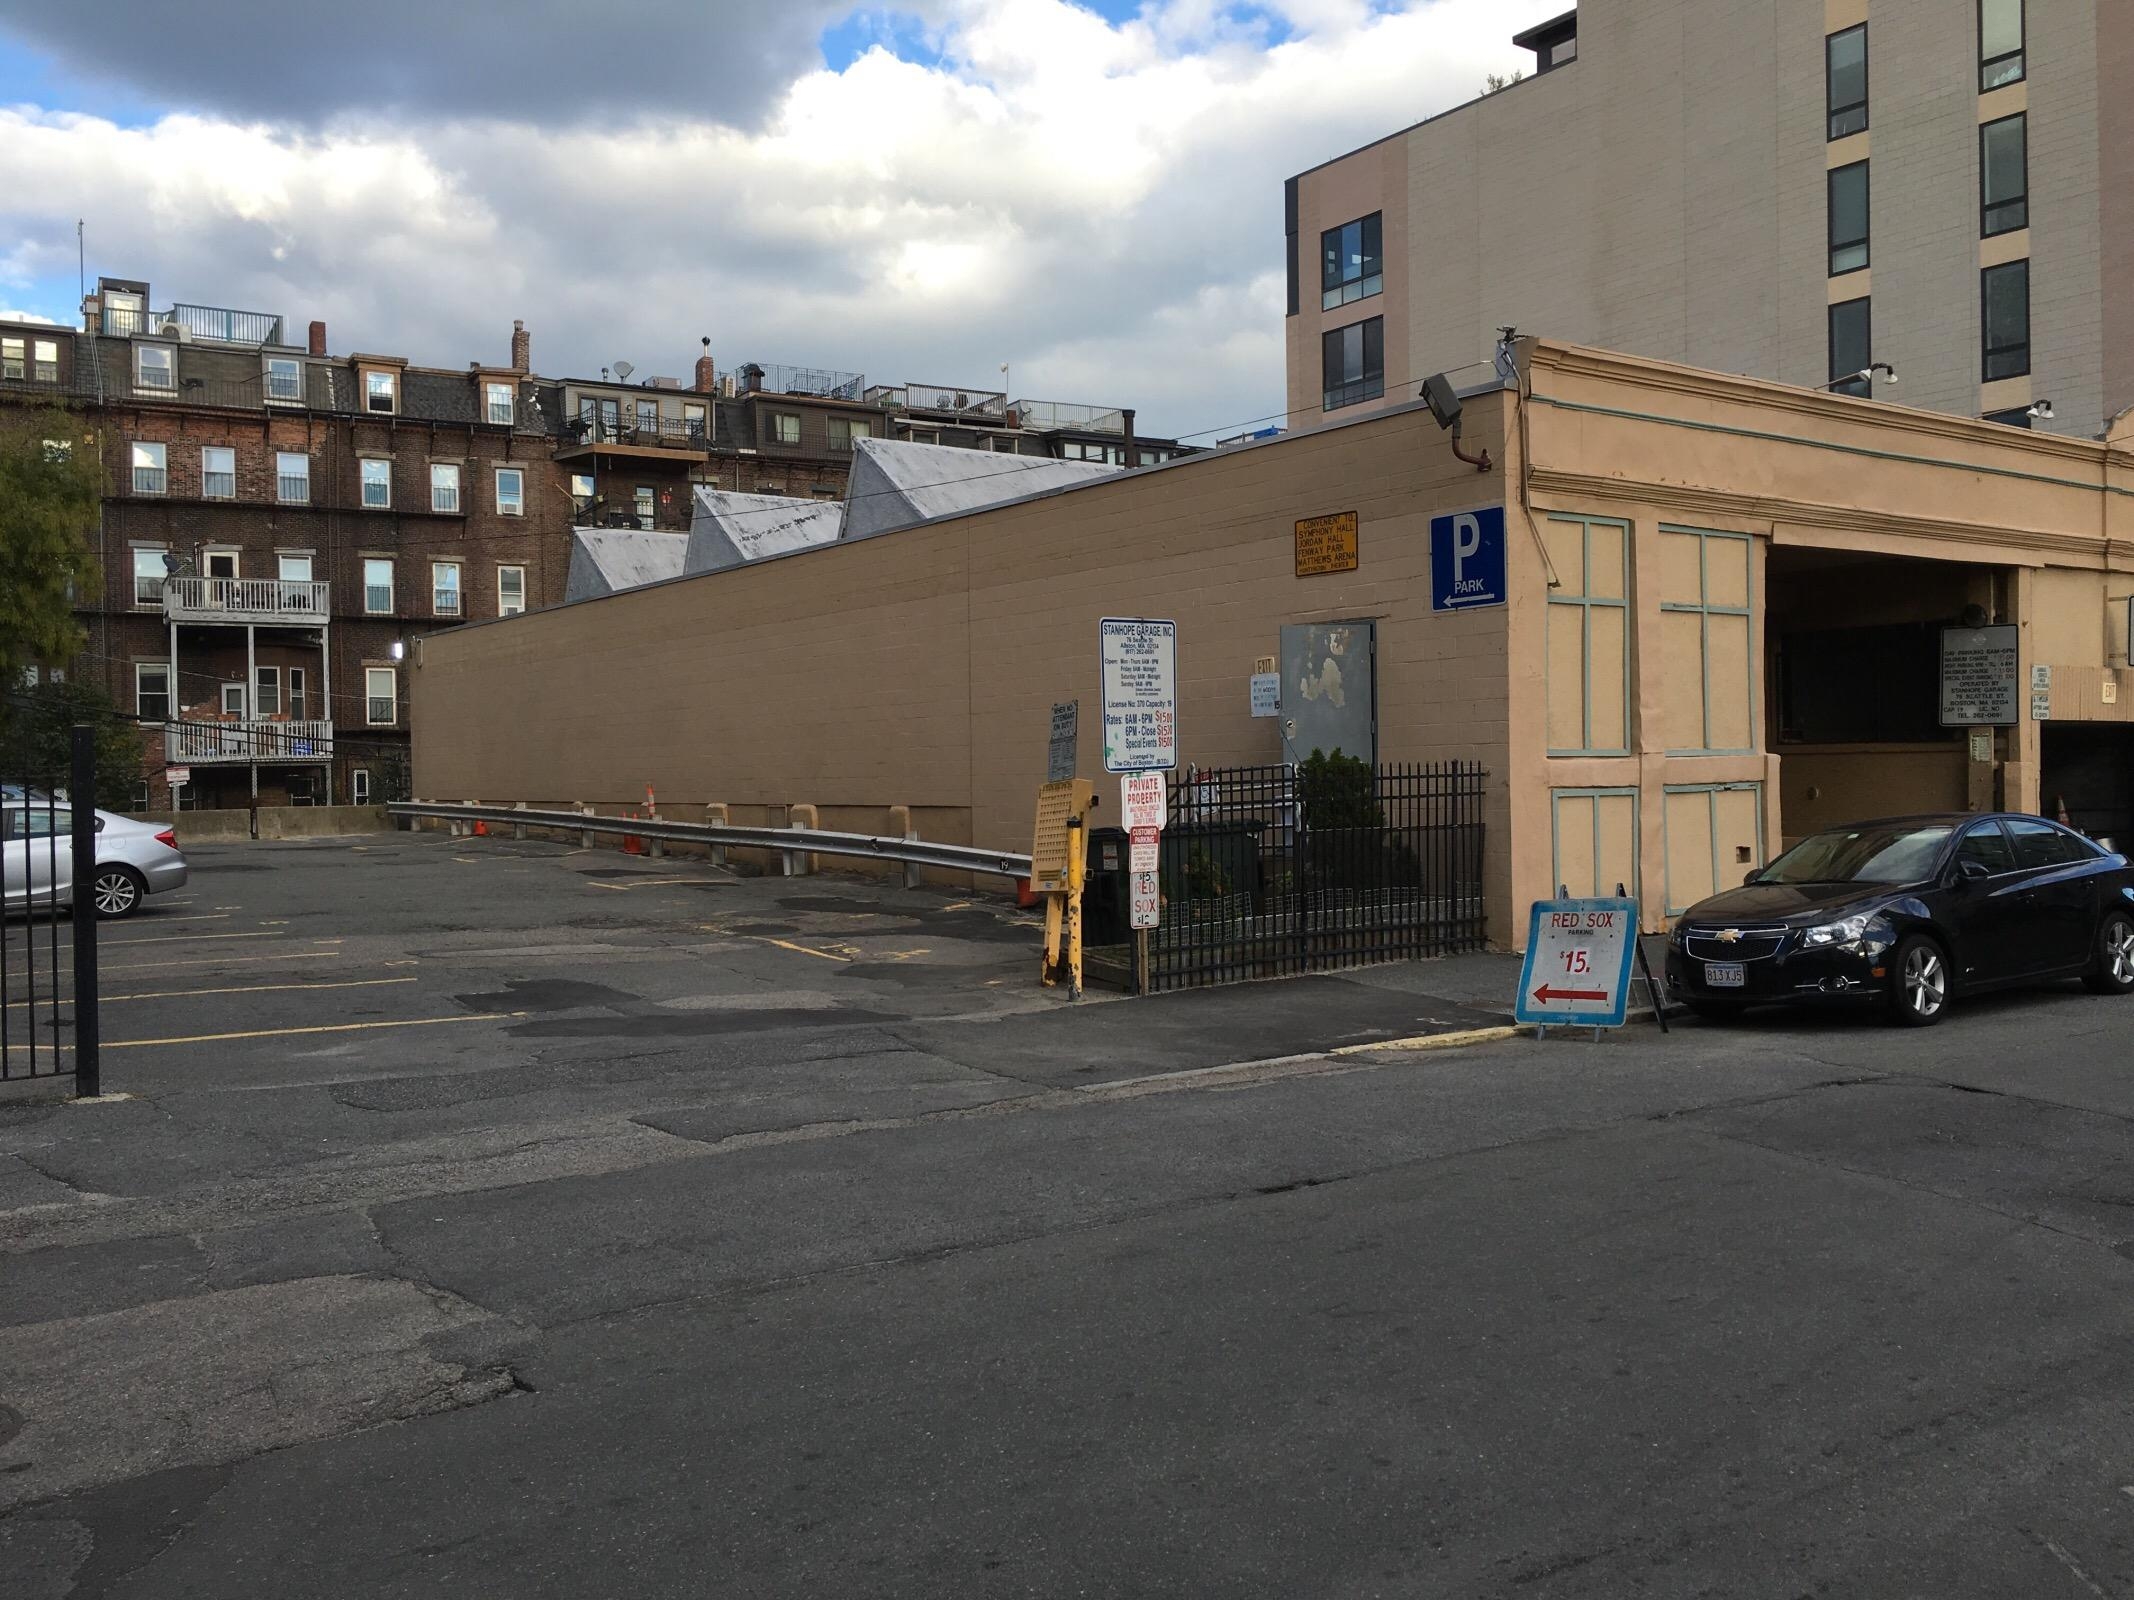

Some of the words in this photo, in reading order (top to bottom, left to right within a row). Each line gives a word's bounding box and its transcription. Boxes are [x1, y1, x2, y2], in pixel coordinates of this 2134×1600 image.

[1336, 523, 1354, 532] HALL
[1327, 534, 1344, 543] HALL
[1327, 544, 1344, 554] PARK
[1453, 513, 1480, 581] P
[1335, 552, 1356, 561] ARENA
[1455, 578, 1484, 594] PARK
[1104, 624, 1135, 636] STANHOPE
[1125, 713, 1138, 724] 6AM
[1142, 713, 1153, 724] 6PM
[1126, 725, 1137, 736] 6PM
[1141, 725, 1156, 736] Close
[1126, 737, 1142, 750] Special
[1142, 737, 1157, 748] Events
[1129, 778, 1158, 791] PRIVATE
[1128, 791, 1161, 804] PROPERTY
[1135, 836, 1155, 844] PARKING
[1001, 861, 1009, 870] 19
[1135, 881, 1156, 894] RED
[1135, 899, 1156, 913] SOX
[1552, 913, 1579, 928] RED
[1587, 913, 1613, 928] SOX
[1707, 970, 1723, 981] 813
[1726, 970, 1742, 981] XJ5
